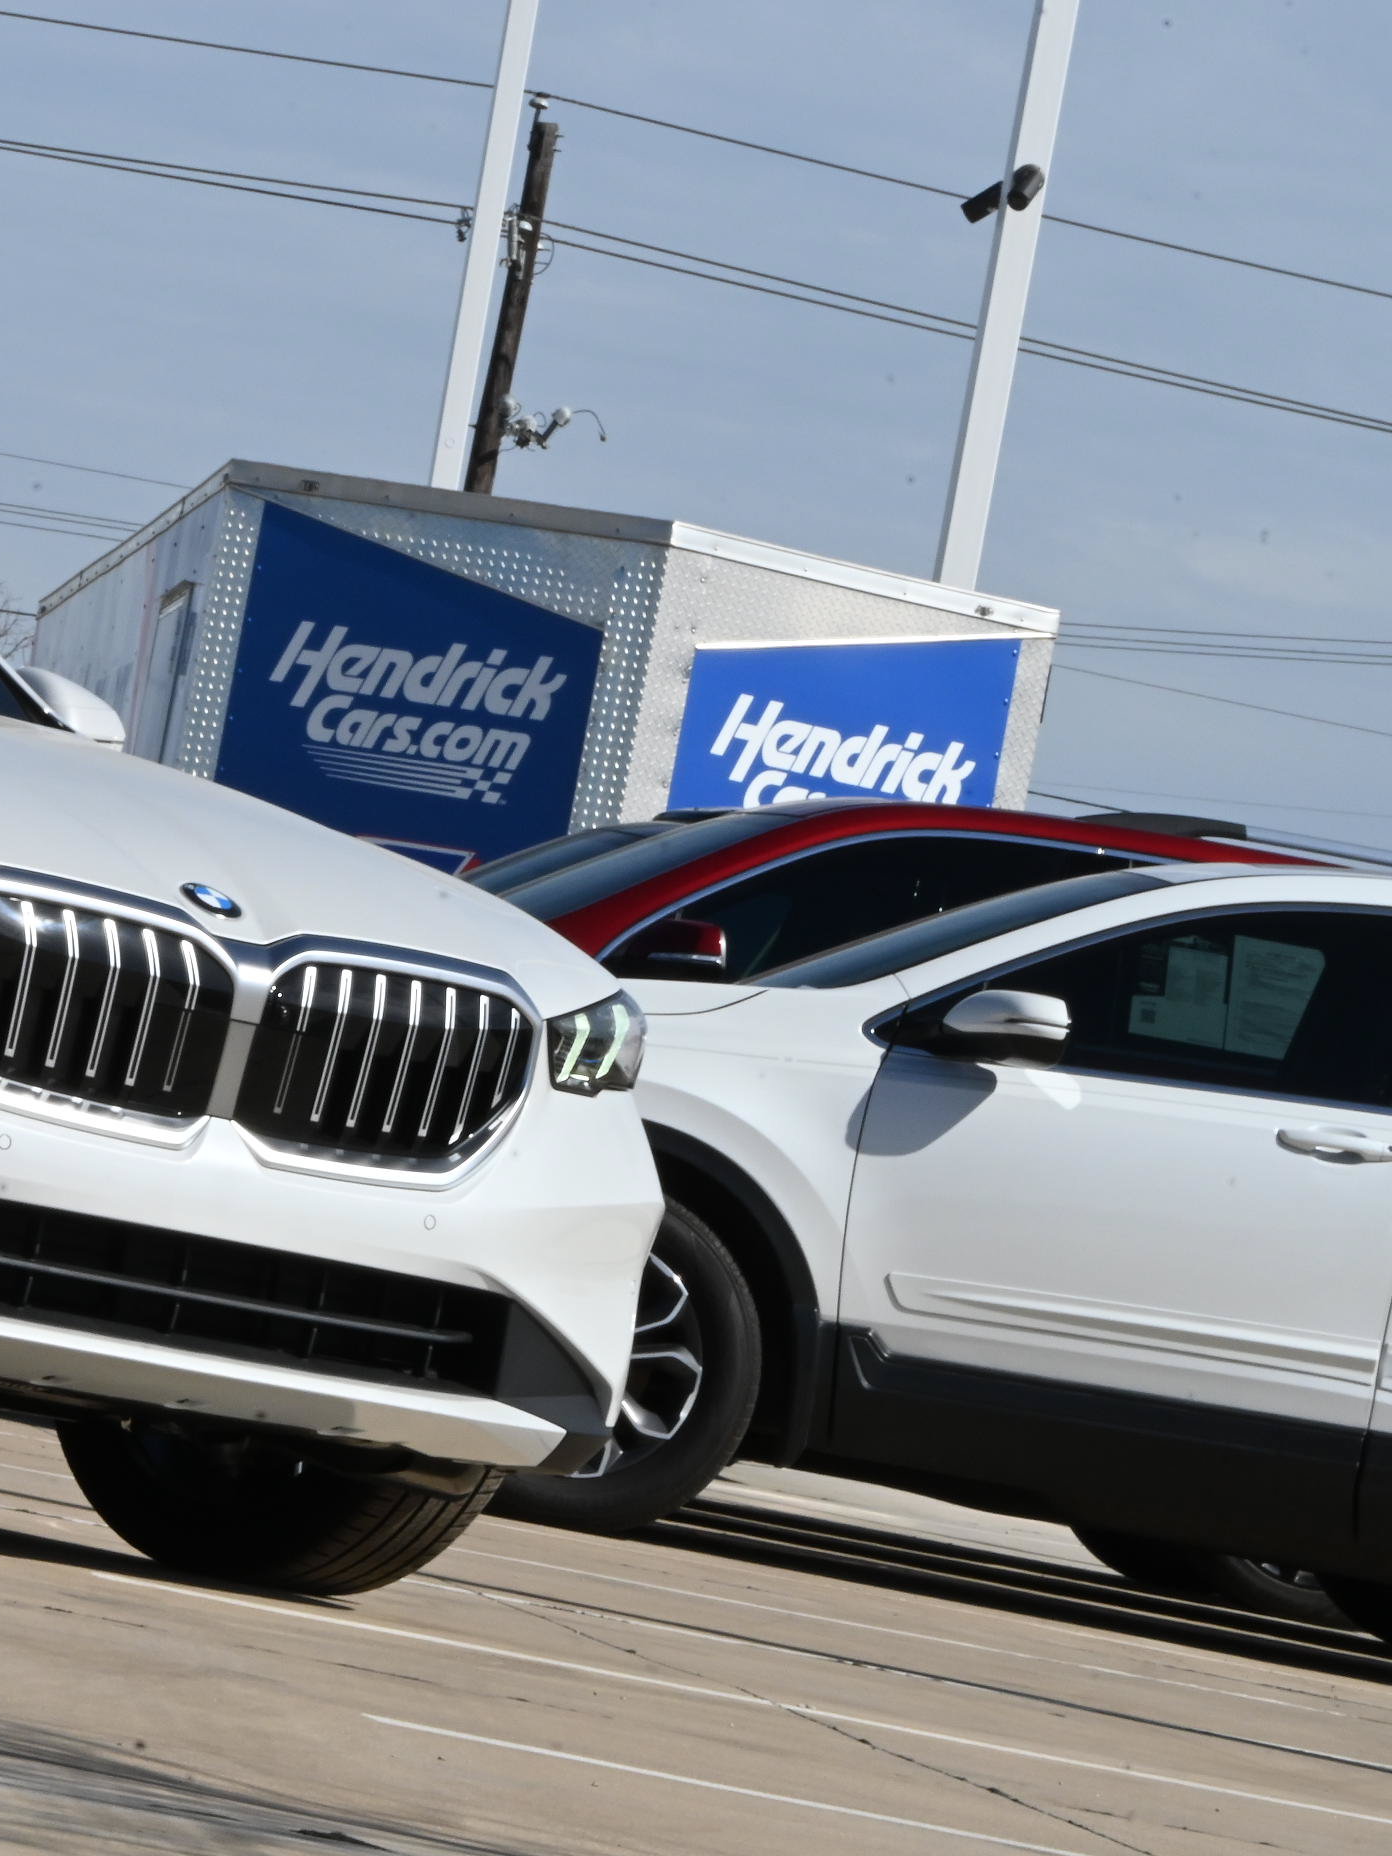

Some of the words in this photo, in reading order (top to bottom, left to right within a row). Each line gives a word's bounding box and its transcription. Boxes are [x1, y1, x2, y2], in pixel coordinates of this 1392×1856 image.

[269, 621, 567, 721] Hendrick
[306, 694, 531, 770] Cars.com
[710, 693, 976, 805] Hendrick
